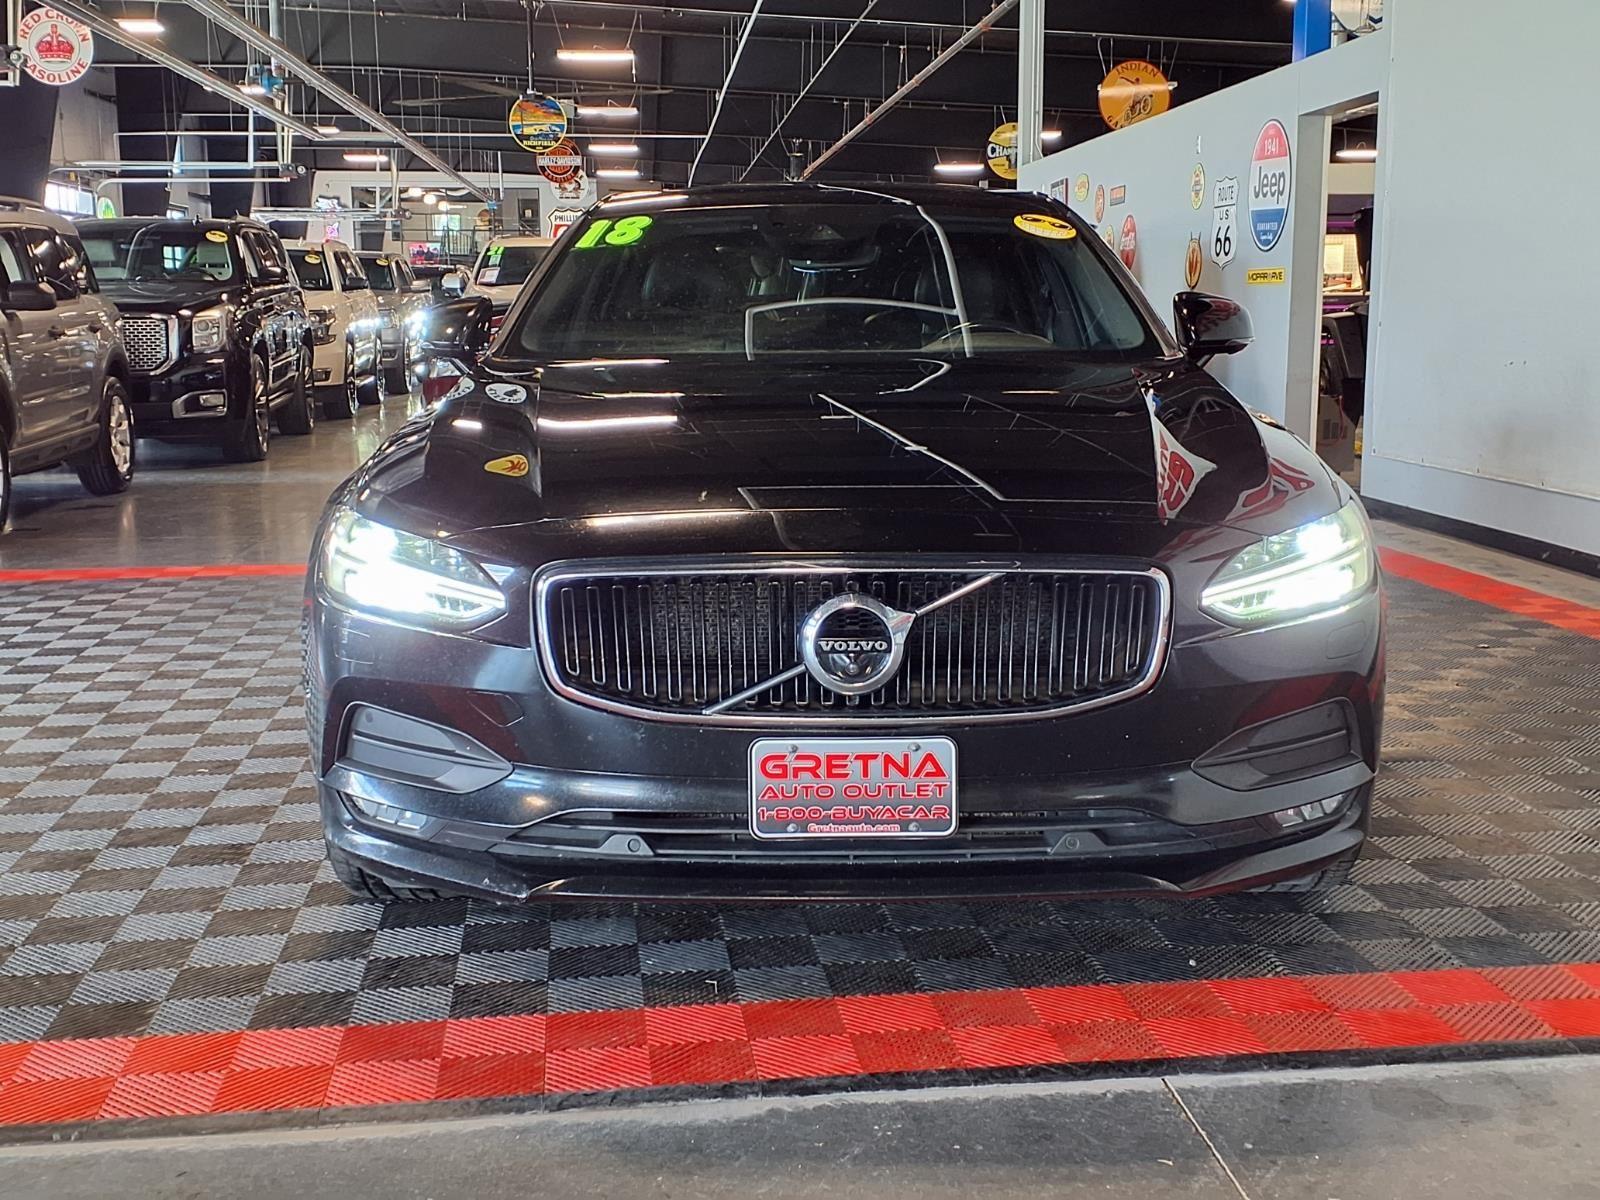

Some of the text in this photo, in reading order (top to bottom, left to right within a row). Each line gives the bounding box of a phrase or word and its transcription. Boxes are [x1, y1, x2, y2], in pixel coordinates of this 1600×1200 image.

[19, 13, 41, 40] RED
[26, 58, 89, 83] ASOLINE
[1116, 62, 1159, 78] INDIAN
[1264, 138, 1279, 155] 1941
[1217, 185, 1235, 202] ROUTE
[1253, 165, 1286, 205] Jeep
[571, 215, 653, 249] 18
[1214, 225, 1232, 257] 66
[817, 640, 888, 652] VOLVO
[759, 751, 950, 780] GRETNA
[759, 782, 951, 800] AUTO OUTLET
[758, 805, 951, 821] 1-800-BUYACAR
[807, 822, 901, 833] Gretnaauto.com
